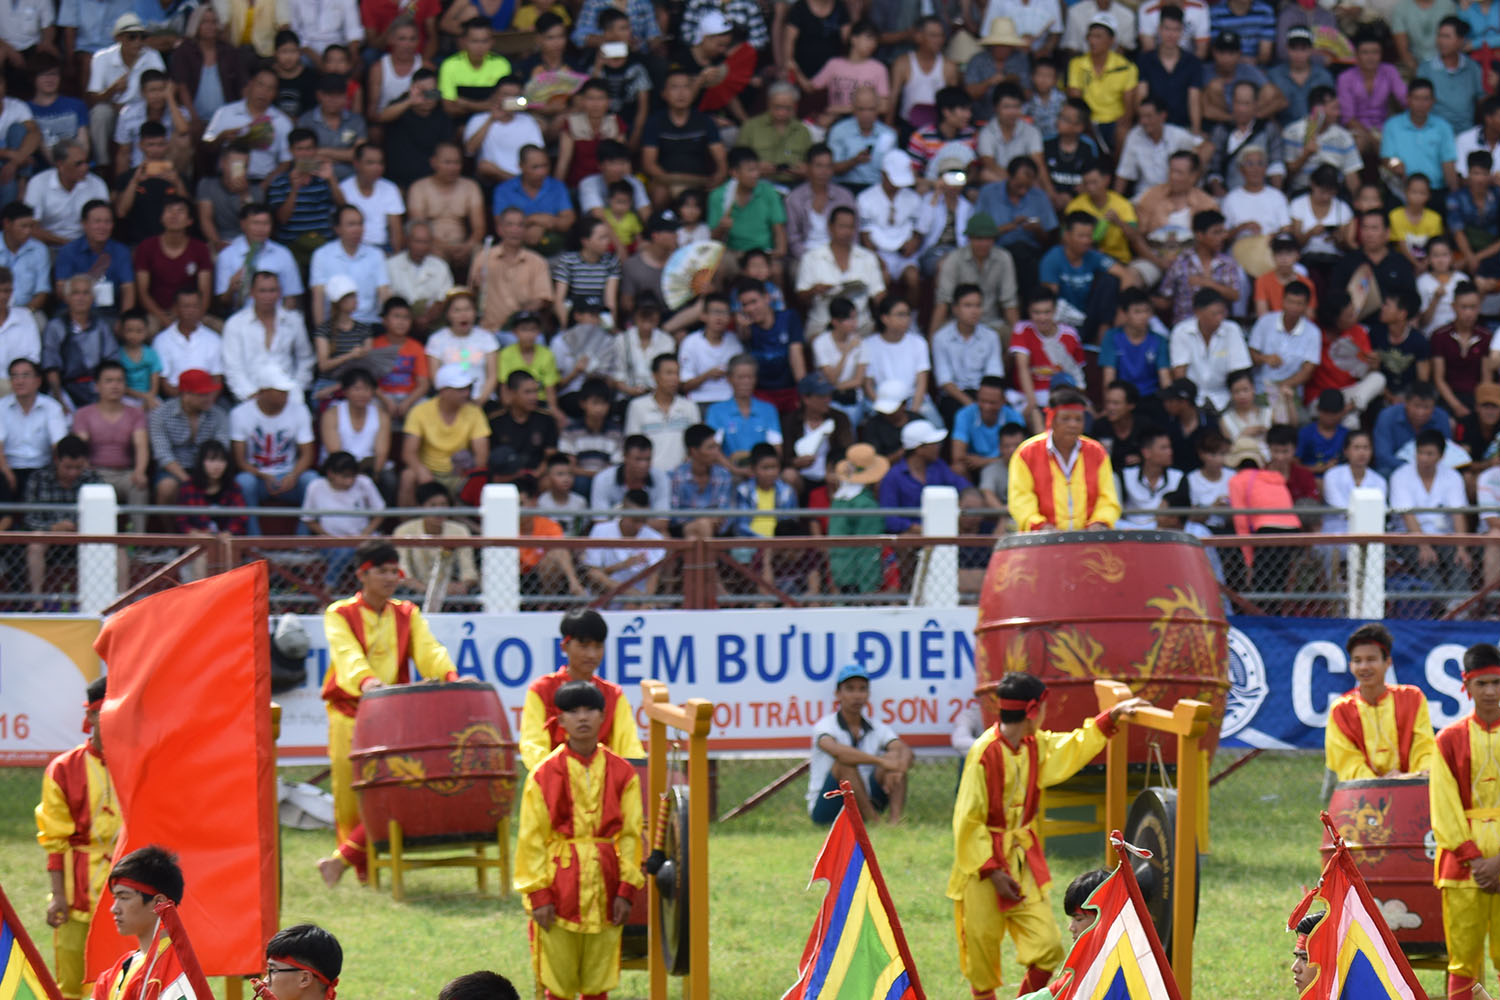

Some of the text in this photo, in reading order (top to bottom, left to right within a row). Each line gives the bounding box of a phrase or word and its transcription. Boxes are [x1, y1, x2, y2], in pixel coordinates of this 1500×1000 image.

[415, 622, 533, 688] ẢO
[717, 624, 835, 684] BƯU
[749, 696, 824, 728] TRÂU
[881, 696, 939, 724] SƠN
